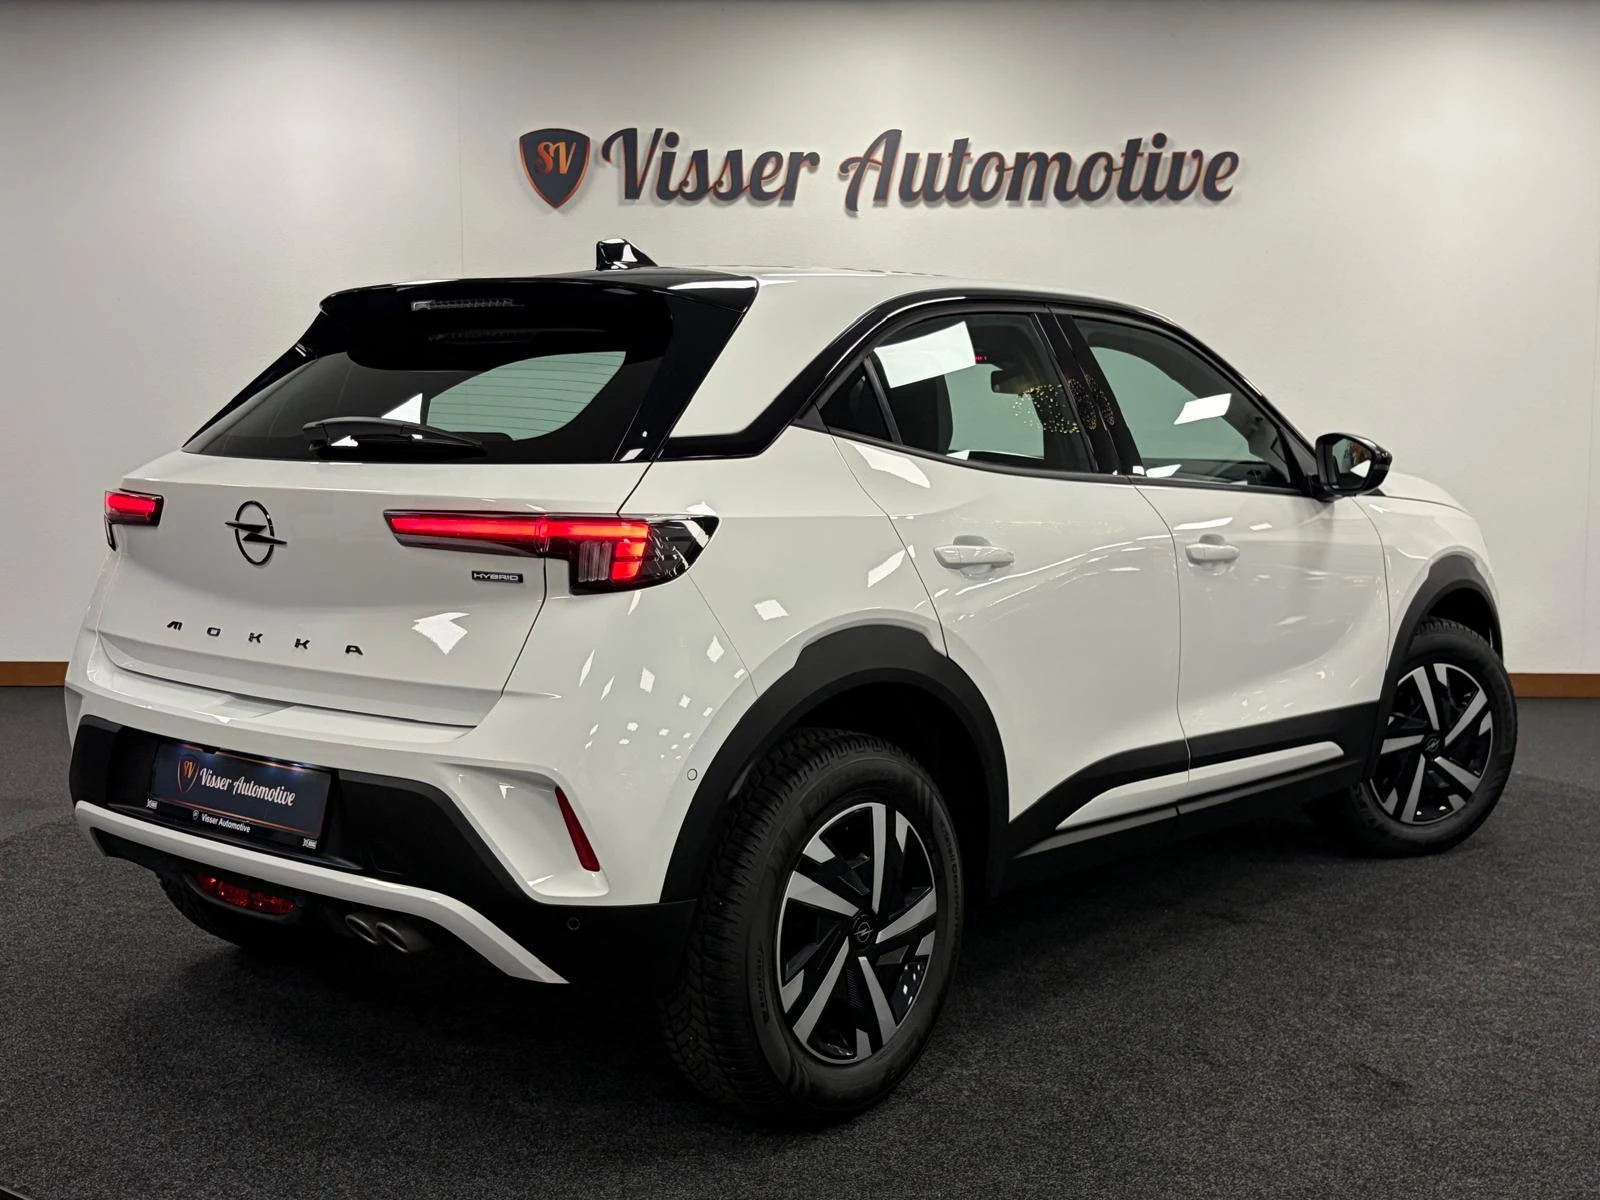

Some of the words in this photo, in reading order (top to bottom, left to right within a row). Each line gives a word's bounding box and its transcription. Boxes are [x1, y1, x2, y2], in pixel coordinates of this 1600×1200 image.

[534, 141, 576, 175] SV
[601, 127, 820, 201] Visser
[839, 128, 1240, 214] Automotive
[473, 572, 519, 581] HYBRID
[167, 619, 364, 656] MOKKA
[200, 767, 231, 790] Visser
[233, 776, 296, 806] Automotive
[201, 813, 218, 825] Visser
[218, 818, 251, 833] Automotive
